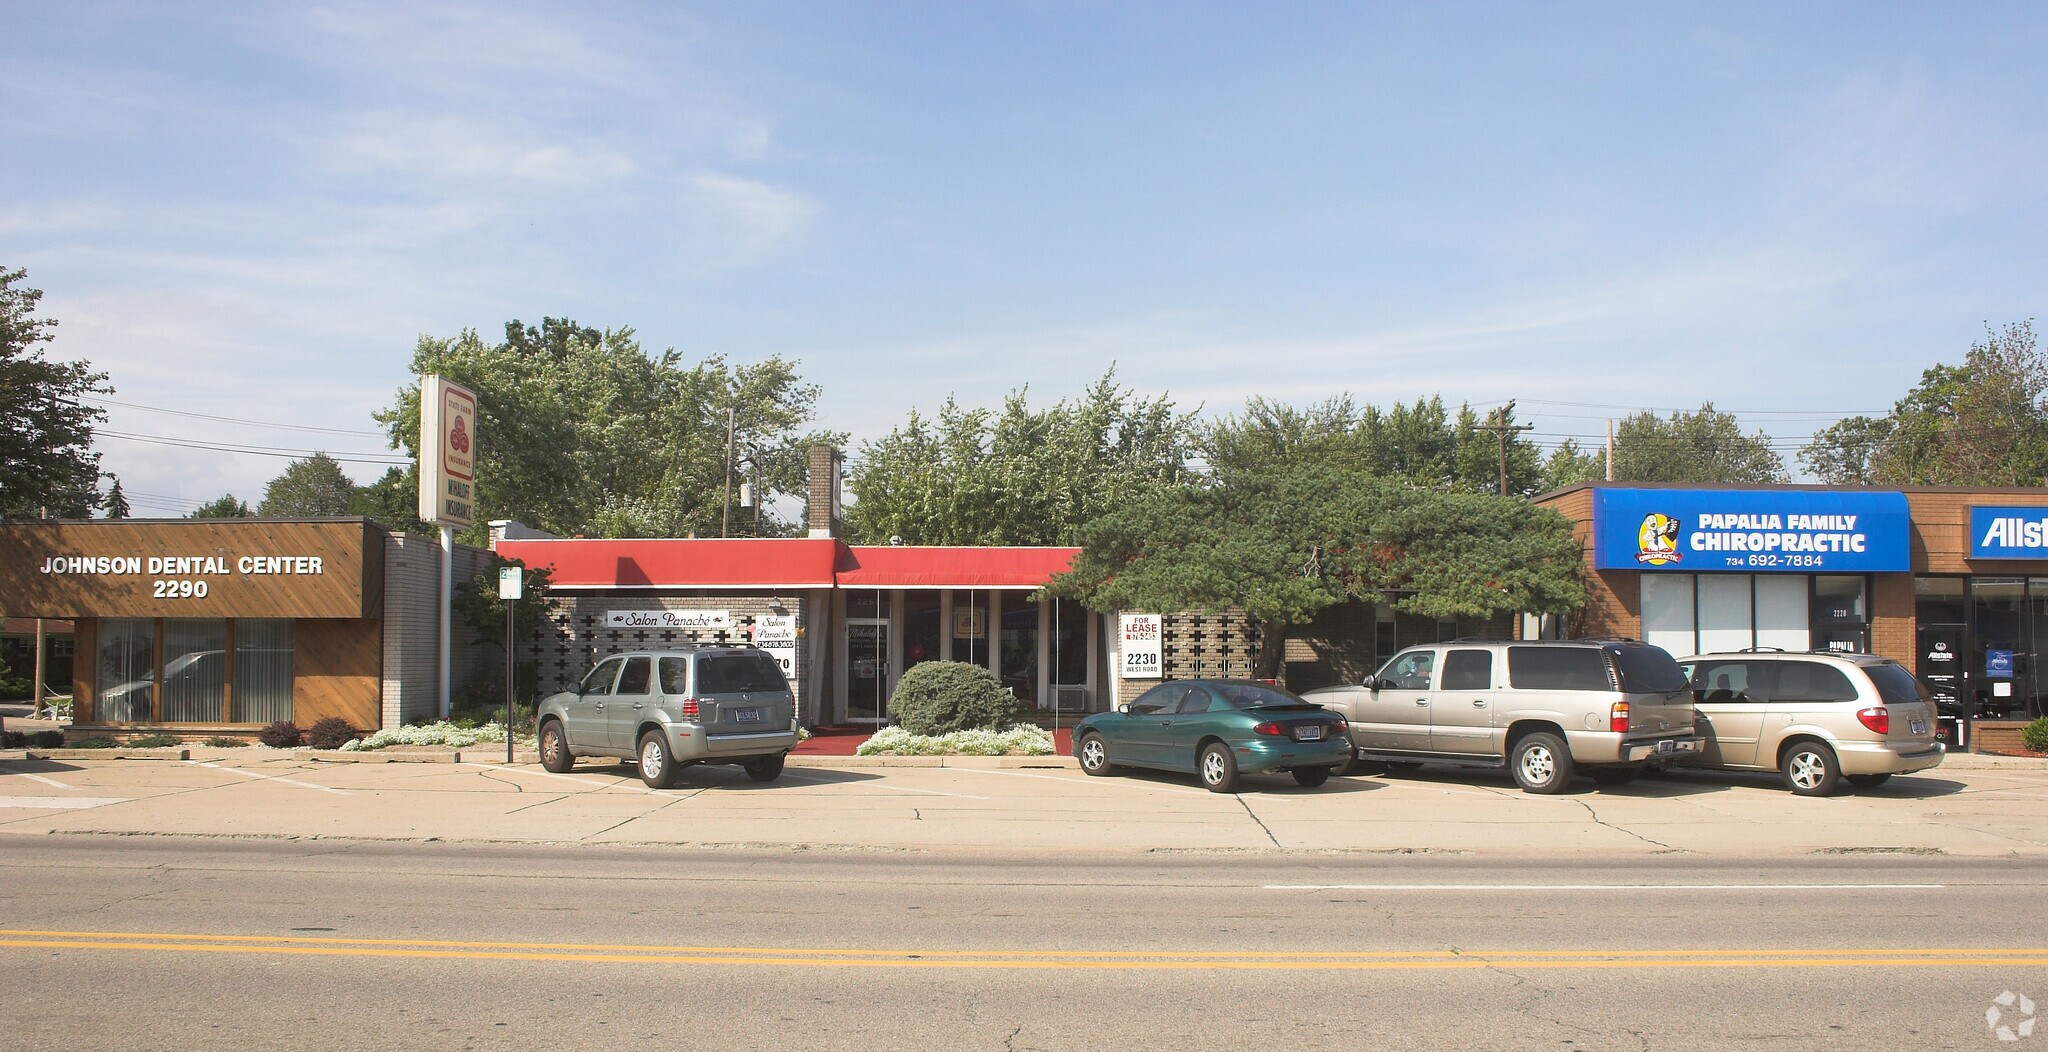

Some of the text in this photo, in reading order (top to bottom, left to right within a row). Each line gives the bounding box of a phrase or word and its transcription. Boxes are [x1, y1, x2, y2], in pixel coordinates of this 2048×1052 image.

[448, 400, 472, 415] STATE FARM
[448, 455, 471, 468] INSURANCE
[446, 499, 471, 520] INSURANCE
[1698, 514, 1857, 531] PAPALIA FAMILY
[1690, 532, 1866, 552] CHIROPRACTIC
[40, 556, 323, 574] JOHNSON DENTAL CENTER
[1725, 555, 1823, 567] 734 692-7884
[153, 580, 208, 598] 2290
[626, 612, 710, 626] Salon Panaché
[762, 617, 786, 626] Salon
[1126, 624, 1157, 632] LEASE
[1127, 653, 1157, 664] 2230
